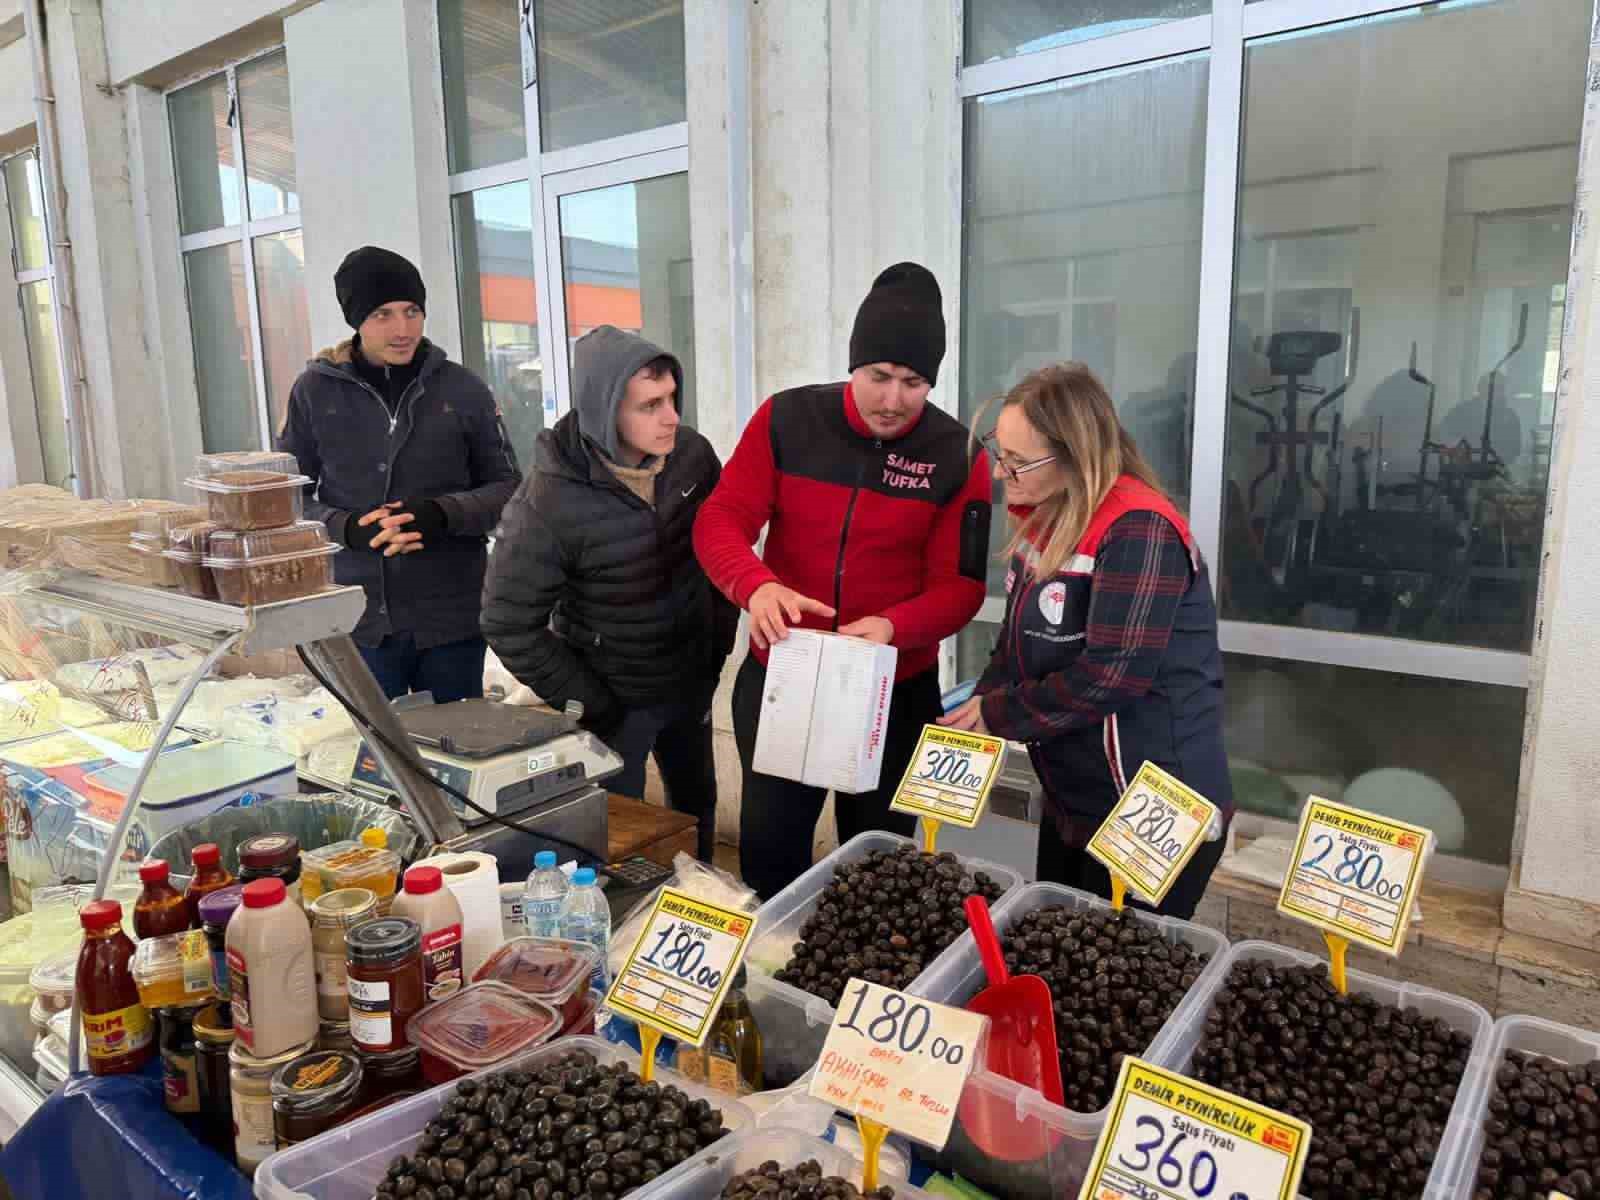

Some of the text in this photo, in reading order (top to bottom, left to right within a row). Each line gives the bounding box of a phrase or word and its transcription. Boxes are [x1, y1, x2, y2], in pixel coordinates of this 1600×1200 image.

[882, 468, 931, 489] YUFKA
[887, 453, 937, 475] SAMET
[838, 983, 964, 1065] 180.00
[1133, 1077, 1257, 1137] DEMİR PEYNİRCİLİK
[1171, 1115, 1201, 1139] Satış
[1202, 1128, 1236, 1152] Fiyatı
